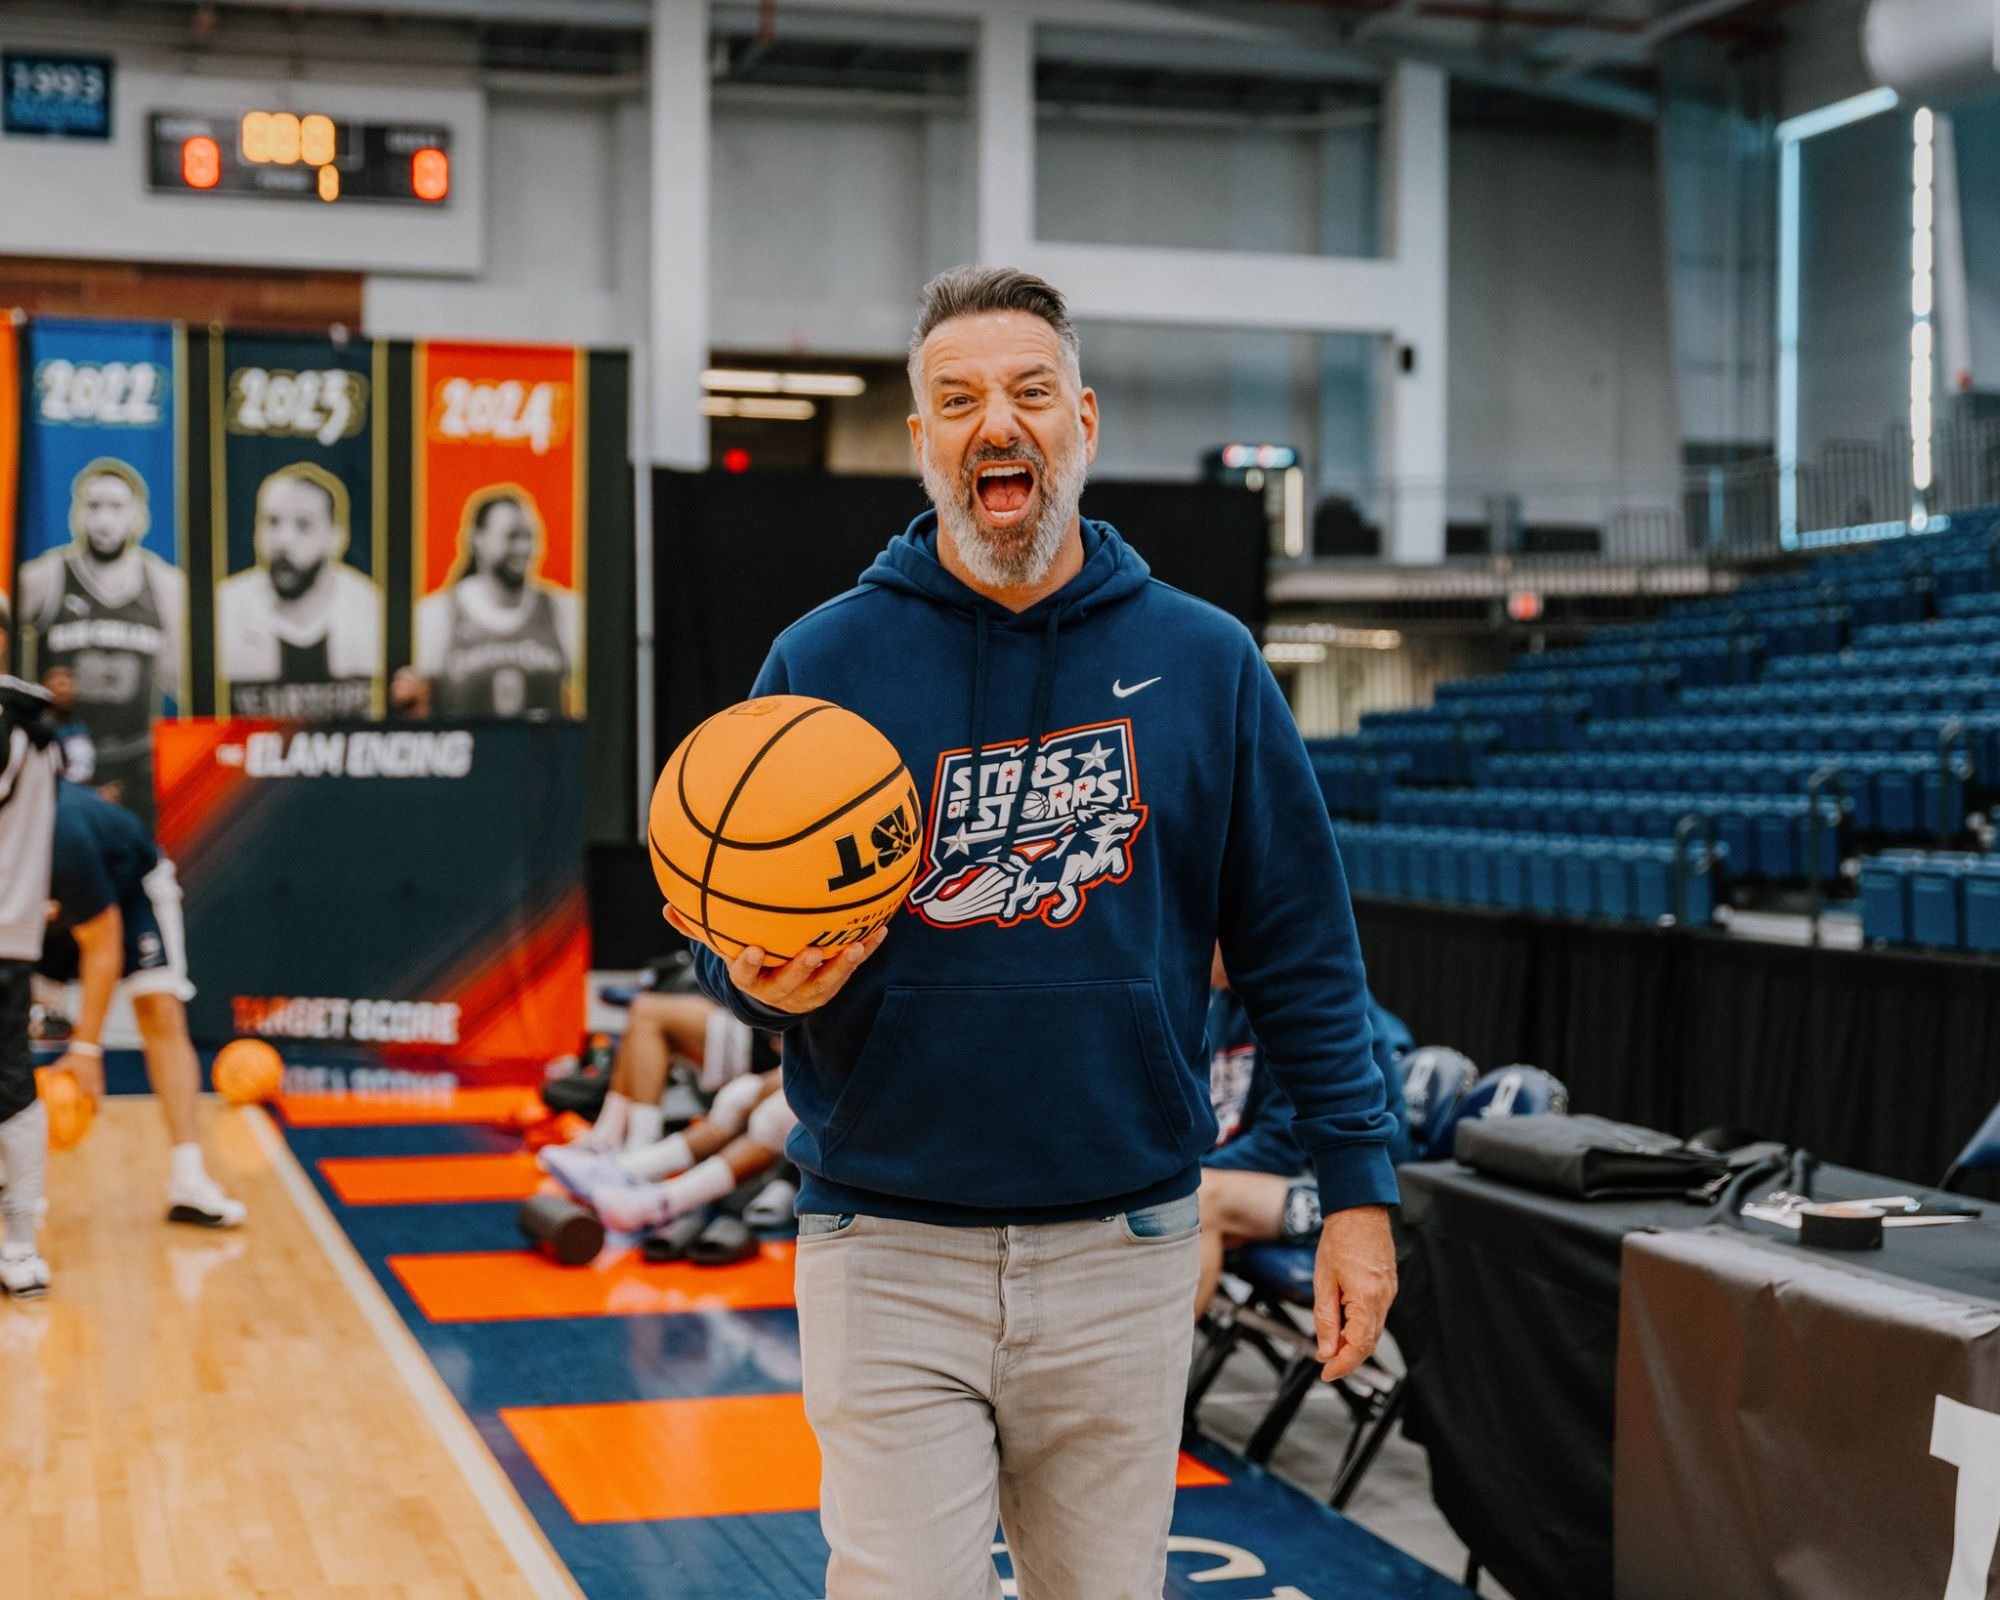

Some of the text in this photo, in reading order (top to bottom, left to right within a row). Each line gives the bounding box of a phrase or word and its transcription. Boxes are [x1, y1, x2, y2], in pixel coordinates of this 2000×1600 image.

[40, 358, 159, 424] 2022
[237, 366, 352, 447] 2023
[439, 376, 557, 456] 2024
[950, 748, 1072, 802] STARS
[947, 800, 971, 819] OF
[350, 999, 460, 1044] SCORE
